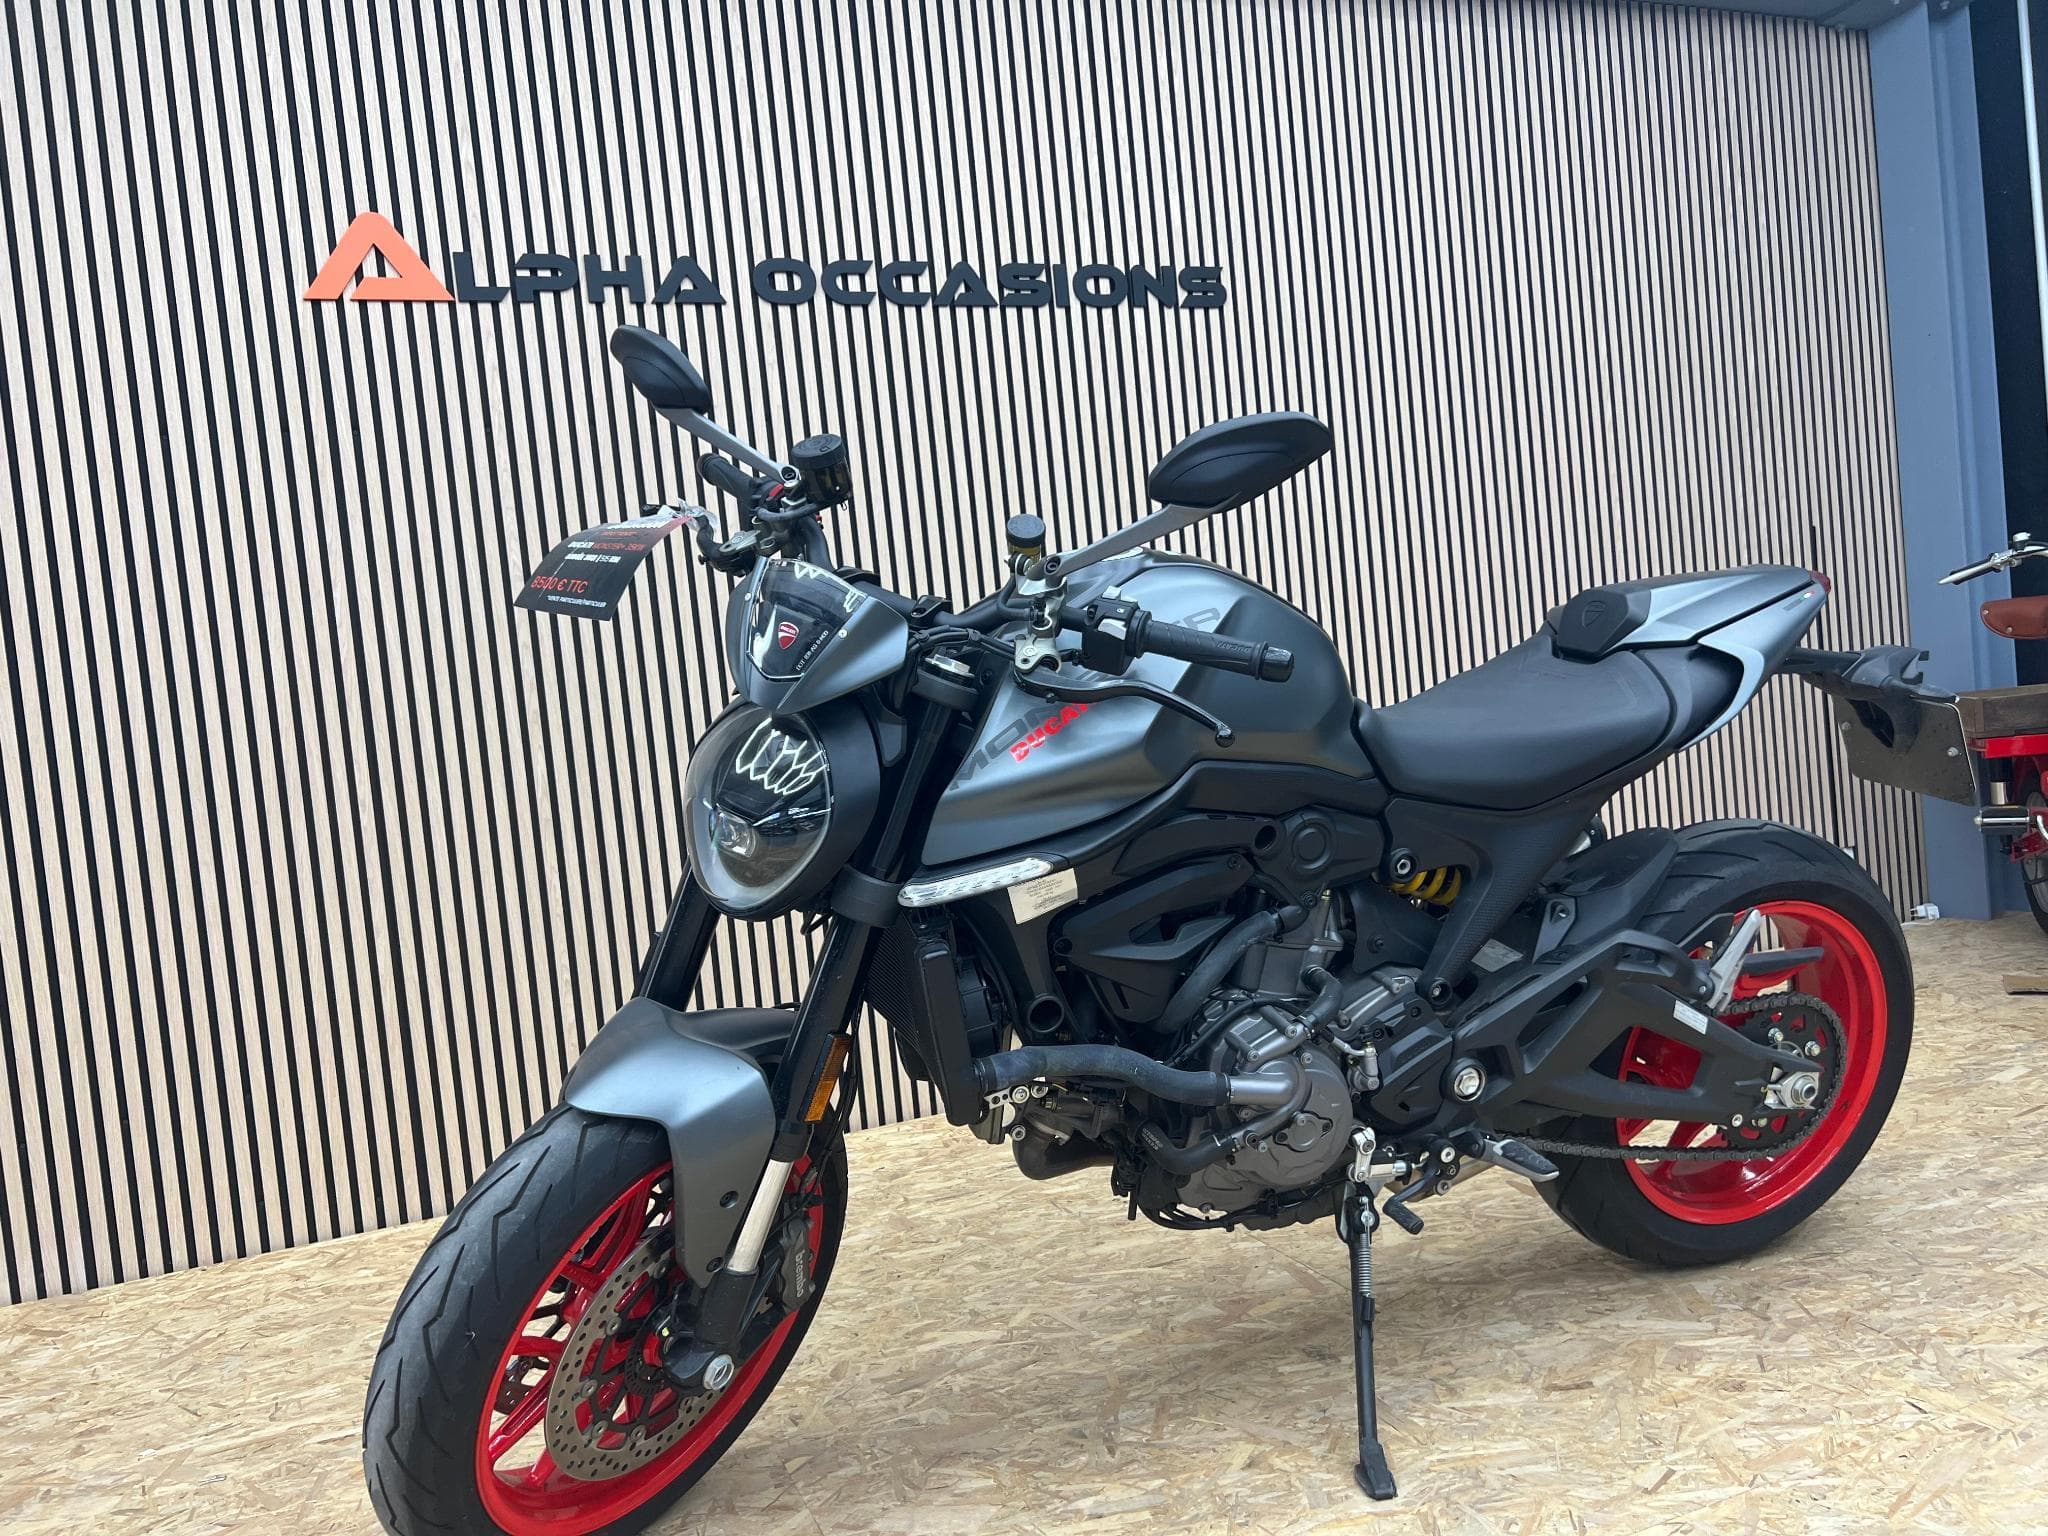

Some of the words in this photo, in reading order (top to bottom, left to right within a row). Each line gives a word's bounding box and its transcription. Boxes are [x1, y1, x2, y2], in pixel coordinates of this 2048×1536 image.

[303, 210, 727, 305] ALPHA
[752, 256, 1228, 309] OCCASIONS
[567, 579, 588, 594] TTC
[1009, 701, 1089, 763] DUCA
[795, 1249, 806, 1298] brembo
